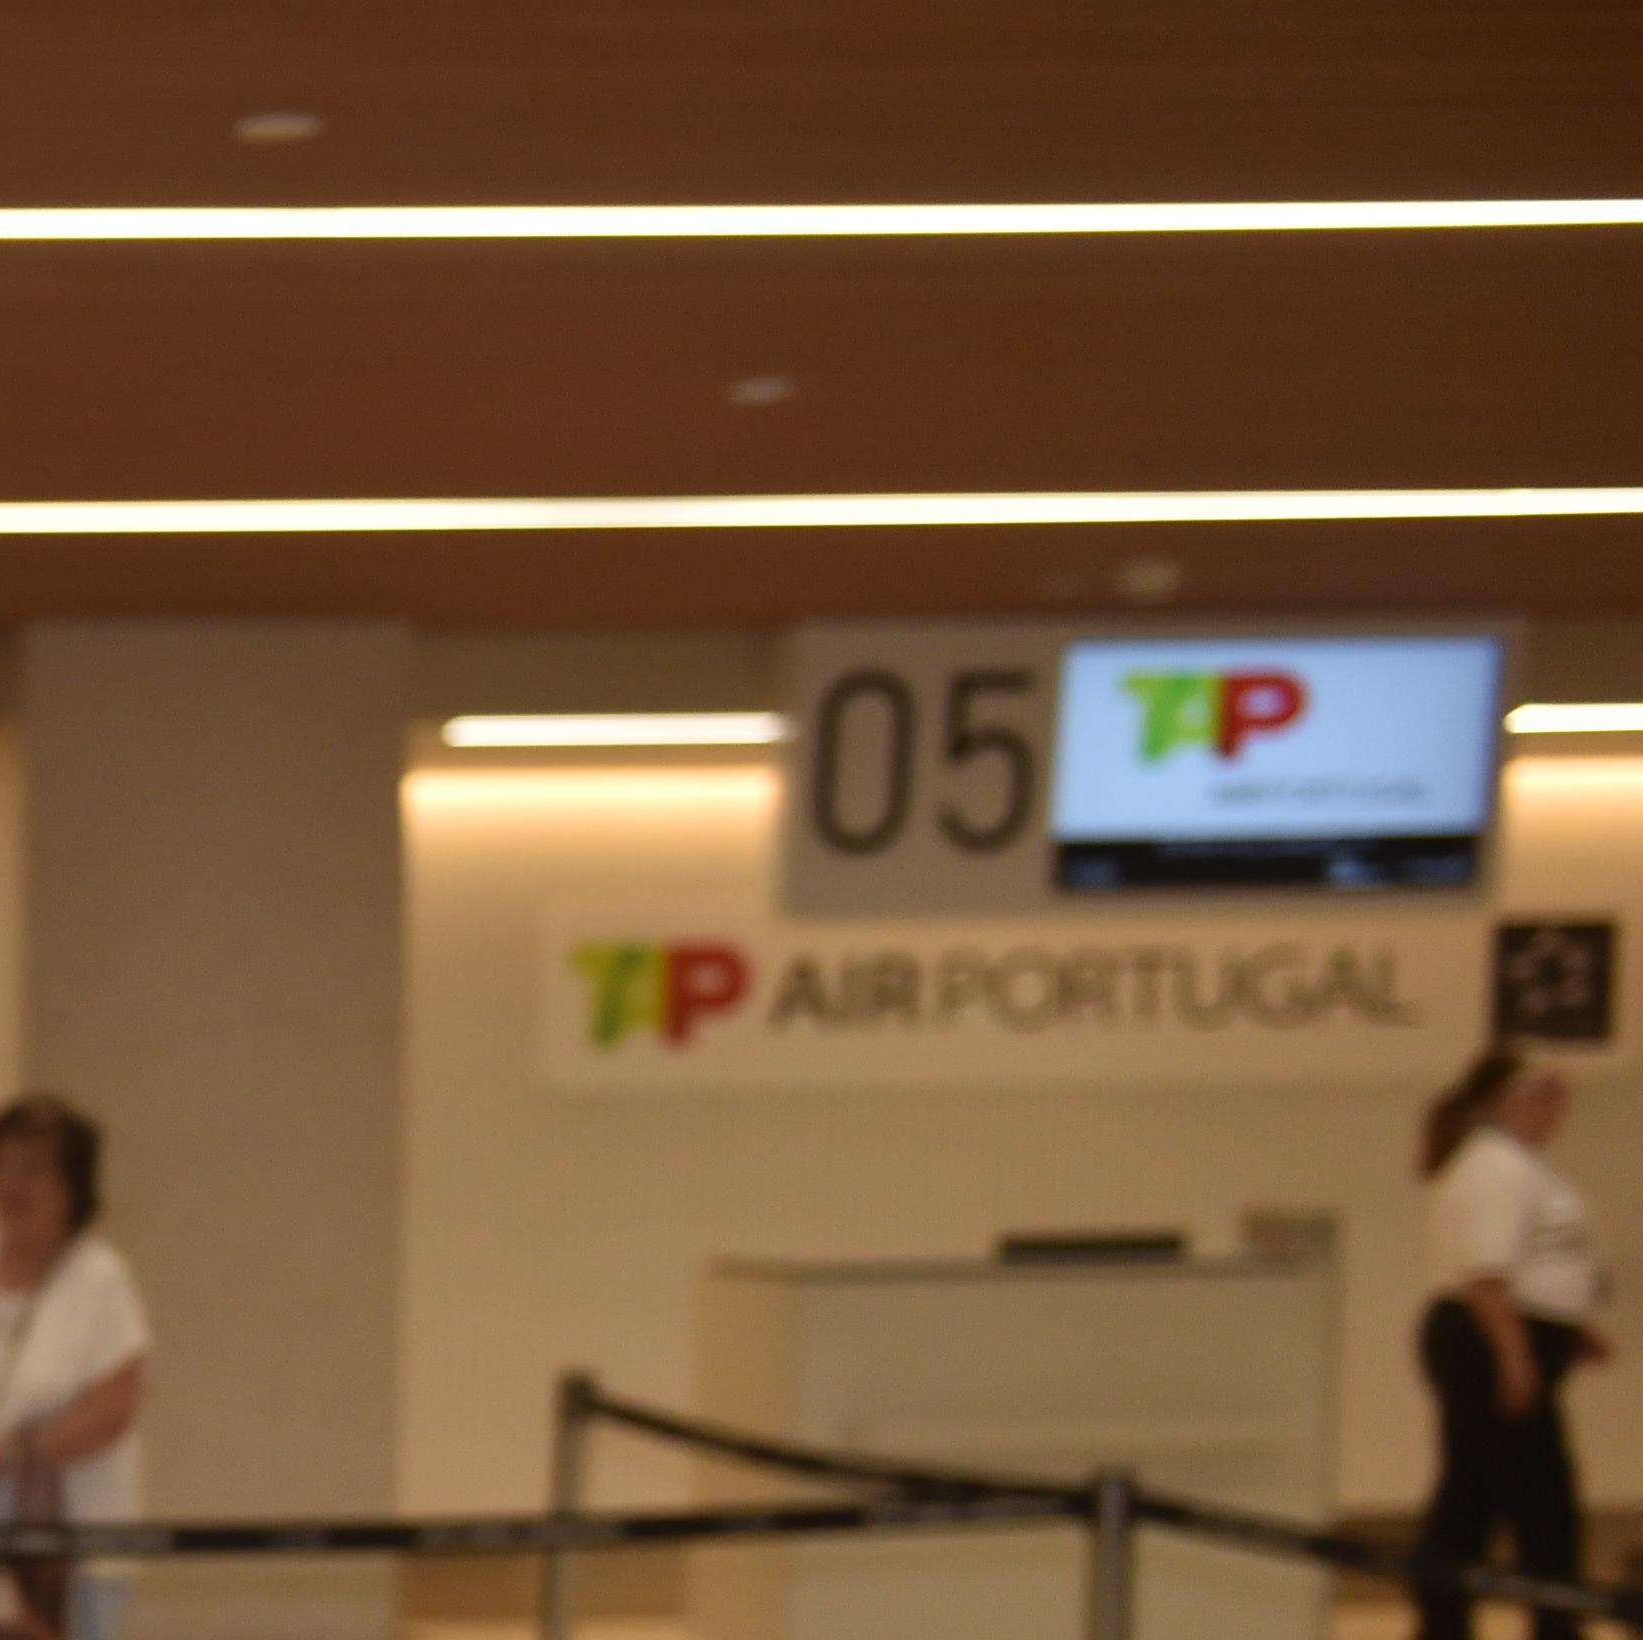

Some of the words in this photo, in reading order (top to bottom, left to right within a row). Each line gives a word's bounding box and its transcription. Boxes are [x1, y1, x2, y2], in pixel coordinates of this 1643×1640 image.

[815, 669, 1036, 855] 05
[1122, 669, 1307, 763] TAP
[570, 940, 755, 1051] TAP
[769, 950, 923, 1034] AIR
[933, 944, 1419, 1033] PORTUGAL
